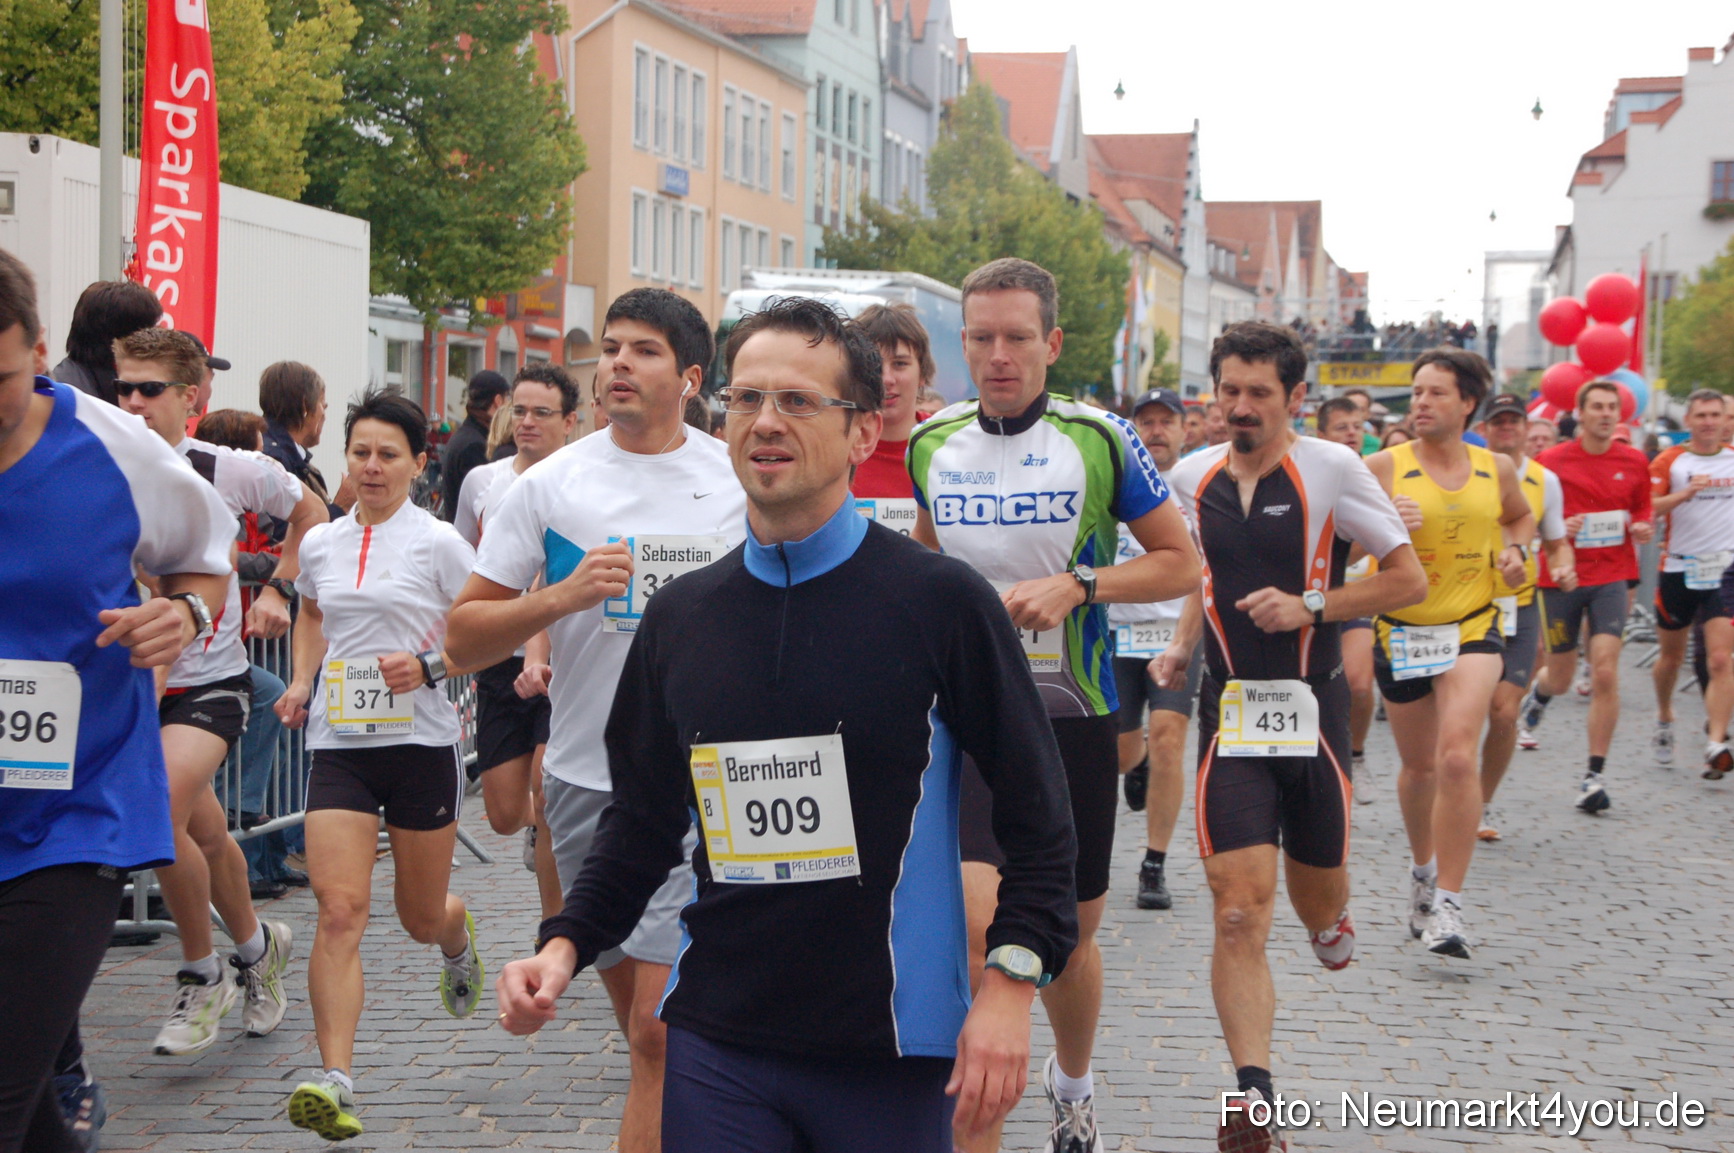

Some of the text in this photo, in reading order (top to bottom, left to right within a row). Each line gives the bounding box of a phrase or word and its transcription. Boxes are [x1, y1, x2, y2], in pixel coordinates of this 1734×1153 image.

[1330, 366, 1385, 380] START
[939, 472, 996, 485] TEAM
[882, 506, 916, 520] Jonas
[933, 491, 1079, 526] BOCK
[642, 544, 712, 563] Sebastian
[1136, 630, 1172, 643] 2212
[1411, 643, 1452, 659] 2176
[346, 665, 380, 680] Gisela
[354, 689, 394, 710] 371
[1246, 688, 1293, 702] Werner
[0, 710, 57, 744] 96
[1256, 711, 1298, 732] 431
[8, 769, 69, 781] PFLEIDERER
[726, 751, 822, 783] Bernhard
[704, 798, 713, 817] B
[745, 796, 821, 837] 909
[792, 855, 856, 873] PFLEIDERER
